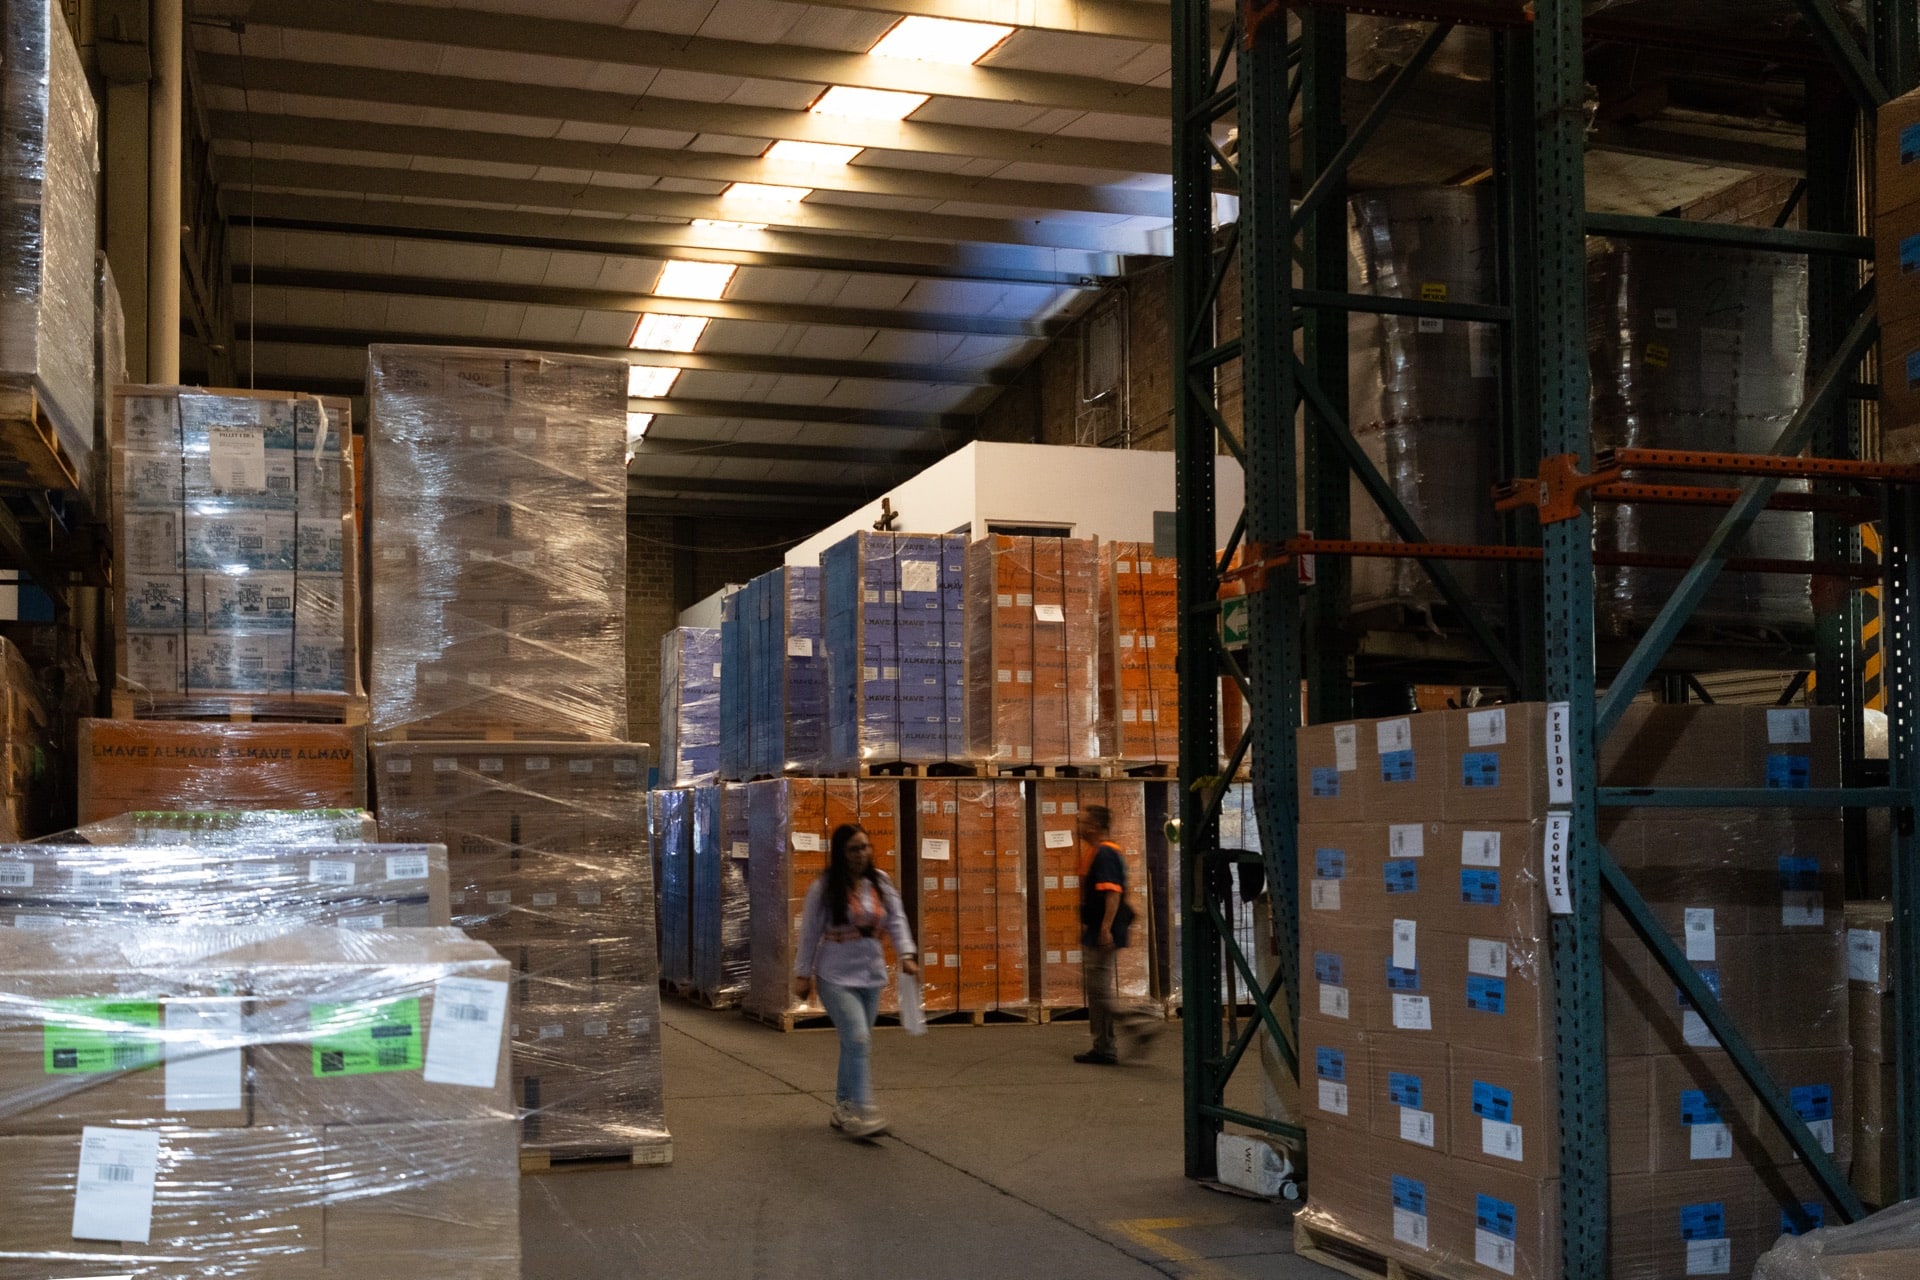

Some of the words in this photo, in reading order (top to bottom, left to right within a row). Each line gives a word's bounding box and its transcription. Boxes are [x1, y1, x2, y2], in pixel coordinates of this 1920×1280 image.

[903, 657, 935, 665] ALMAVE
[92, 745, 150, 758] LMAVE
[153, 745, 220, 759] ALMAVE
[227, 746, 292, 760] ALMAVE
[296, 747, 352, 761] ALMAV
[1553, 711, 1564, 788] PEDIDOS
[1551, 821, 1563, 897] ECOMMEX
